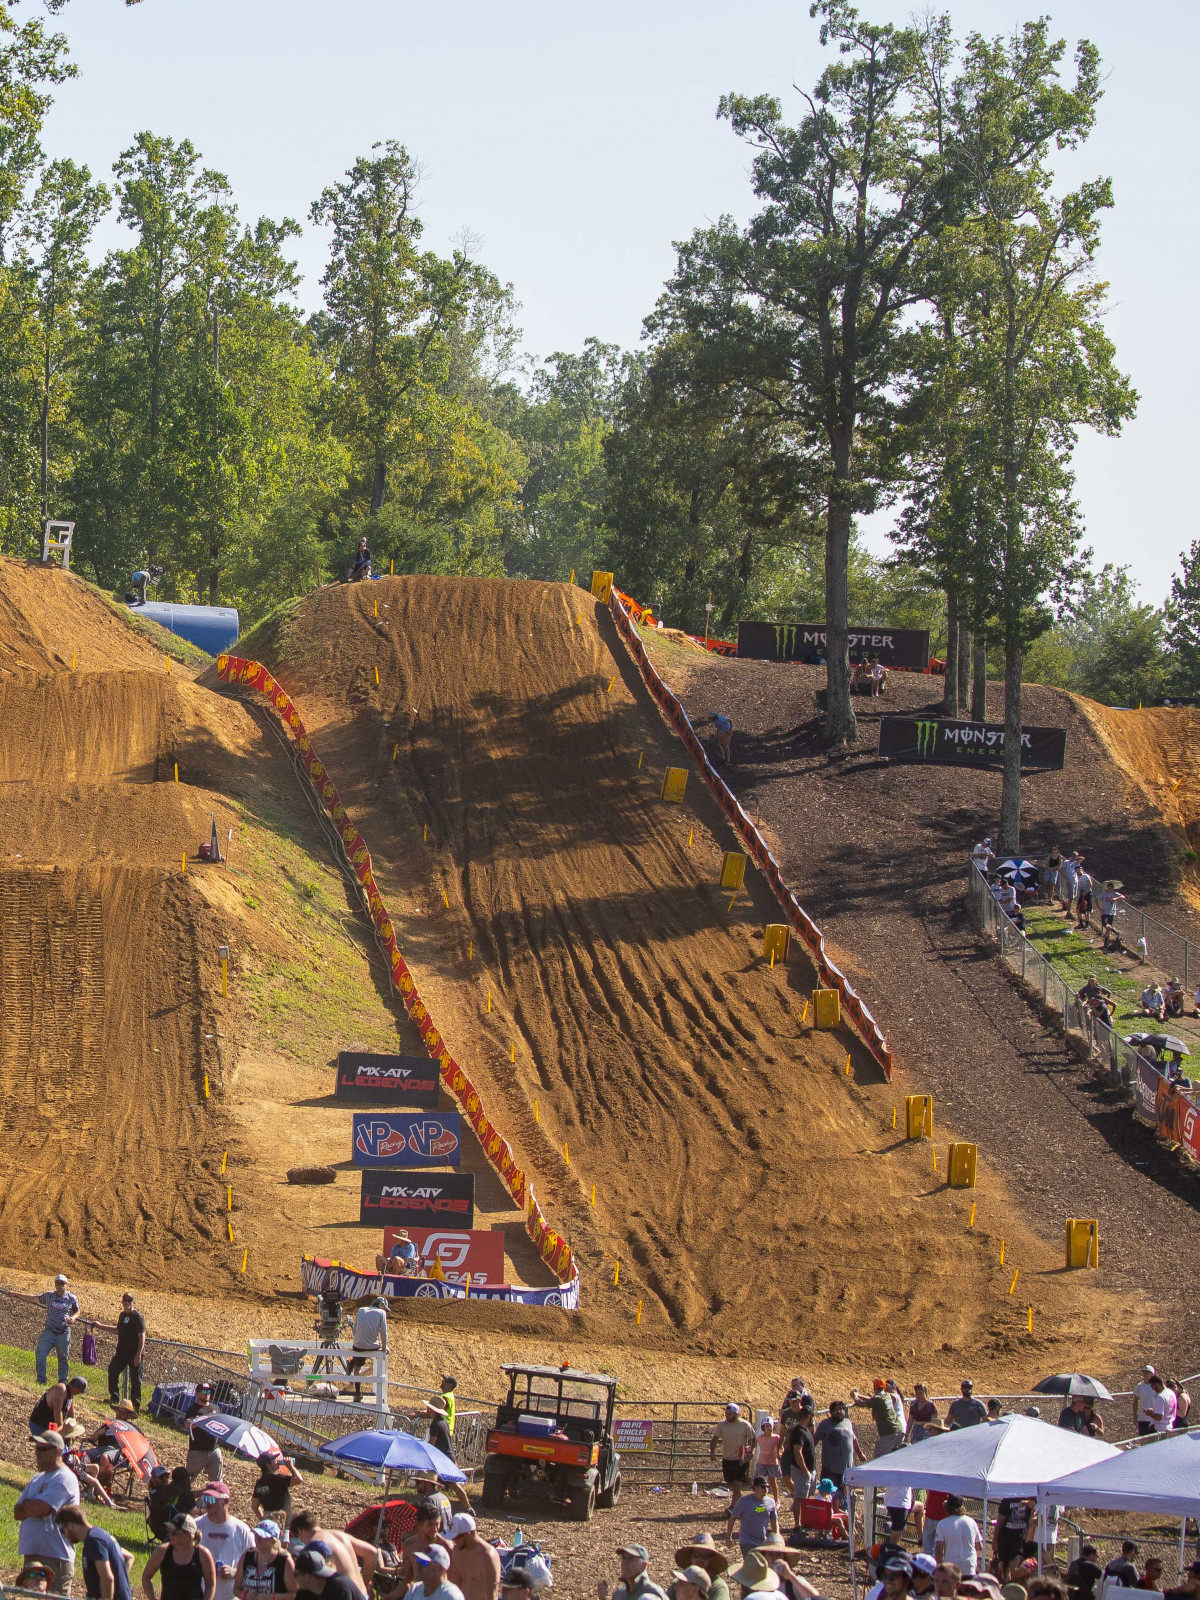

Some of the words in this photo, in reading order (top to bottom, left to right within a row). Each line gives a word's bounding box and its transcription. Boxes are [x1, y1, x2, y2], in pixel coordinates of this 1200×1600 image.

[341, 1074, 436, 1092] LEGENDS
[357, 1121, 392, 1156] VP
[409, 1121, 444, 1156] VP
[364, 1195, 470, 1213] LEGENDS
[631, 1421, 643, 1429] PIT
[618, 1435, 644, 1443] BEYOND
